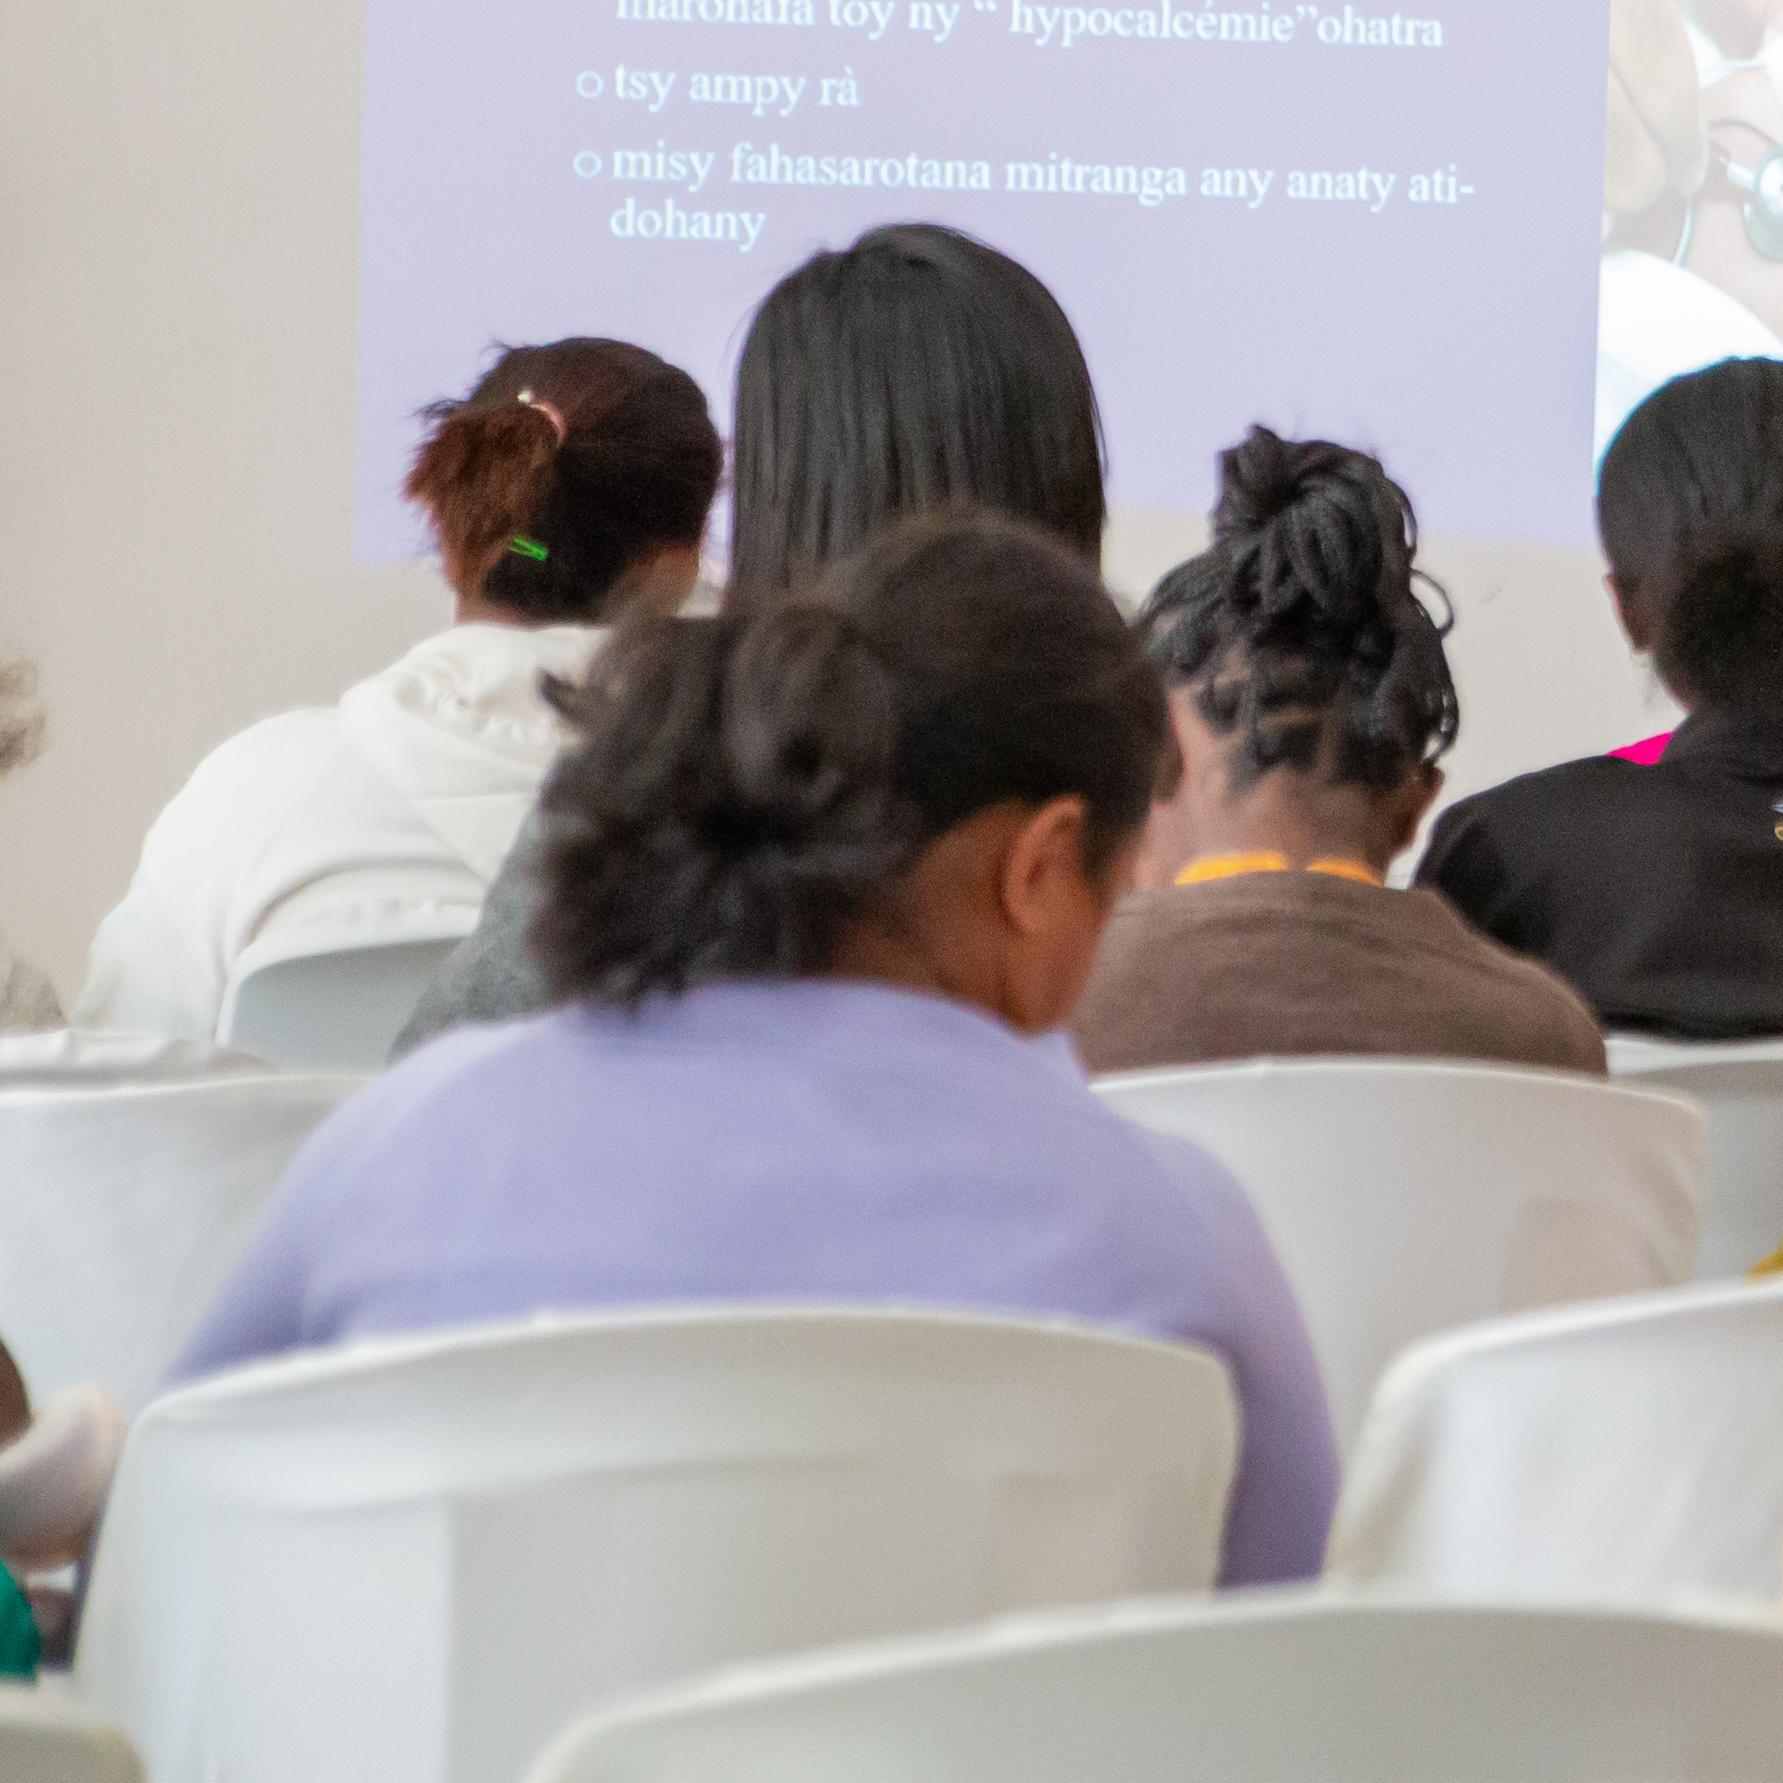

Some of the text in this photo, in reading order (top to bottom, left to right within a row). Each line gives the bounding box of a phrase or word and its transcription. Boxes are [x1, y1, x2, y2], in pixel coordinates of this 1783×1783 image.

[908, 0, 960, 43] ny
[614, 63, 677, 113] tsy
[689, 70, 806, 116] ampy
[612, 139, 1476, 213] misy fahasarotana mitranga any anaty ati-
[609, 197, 767, 253] dohany
